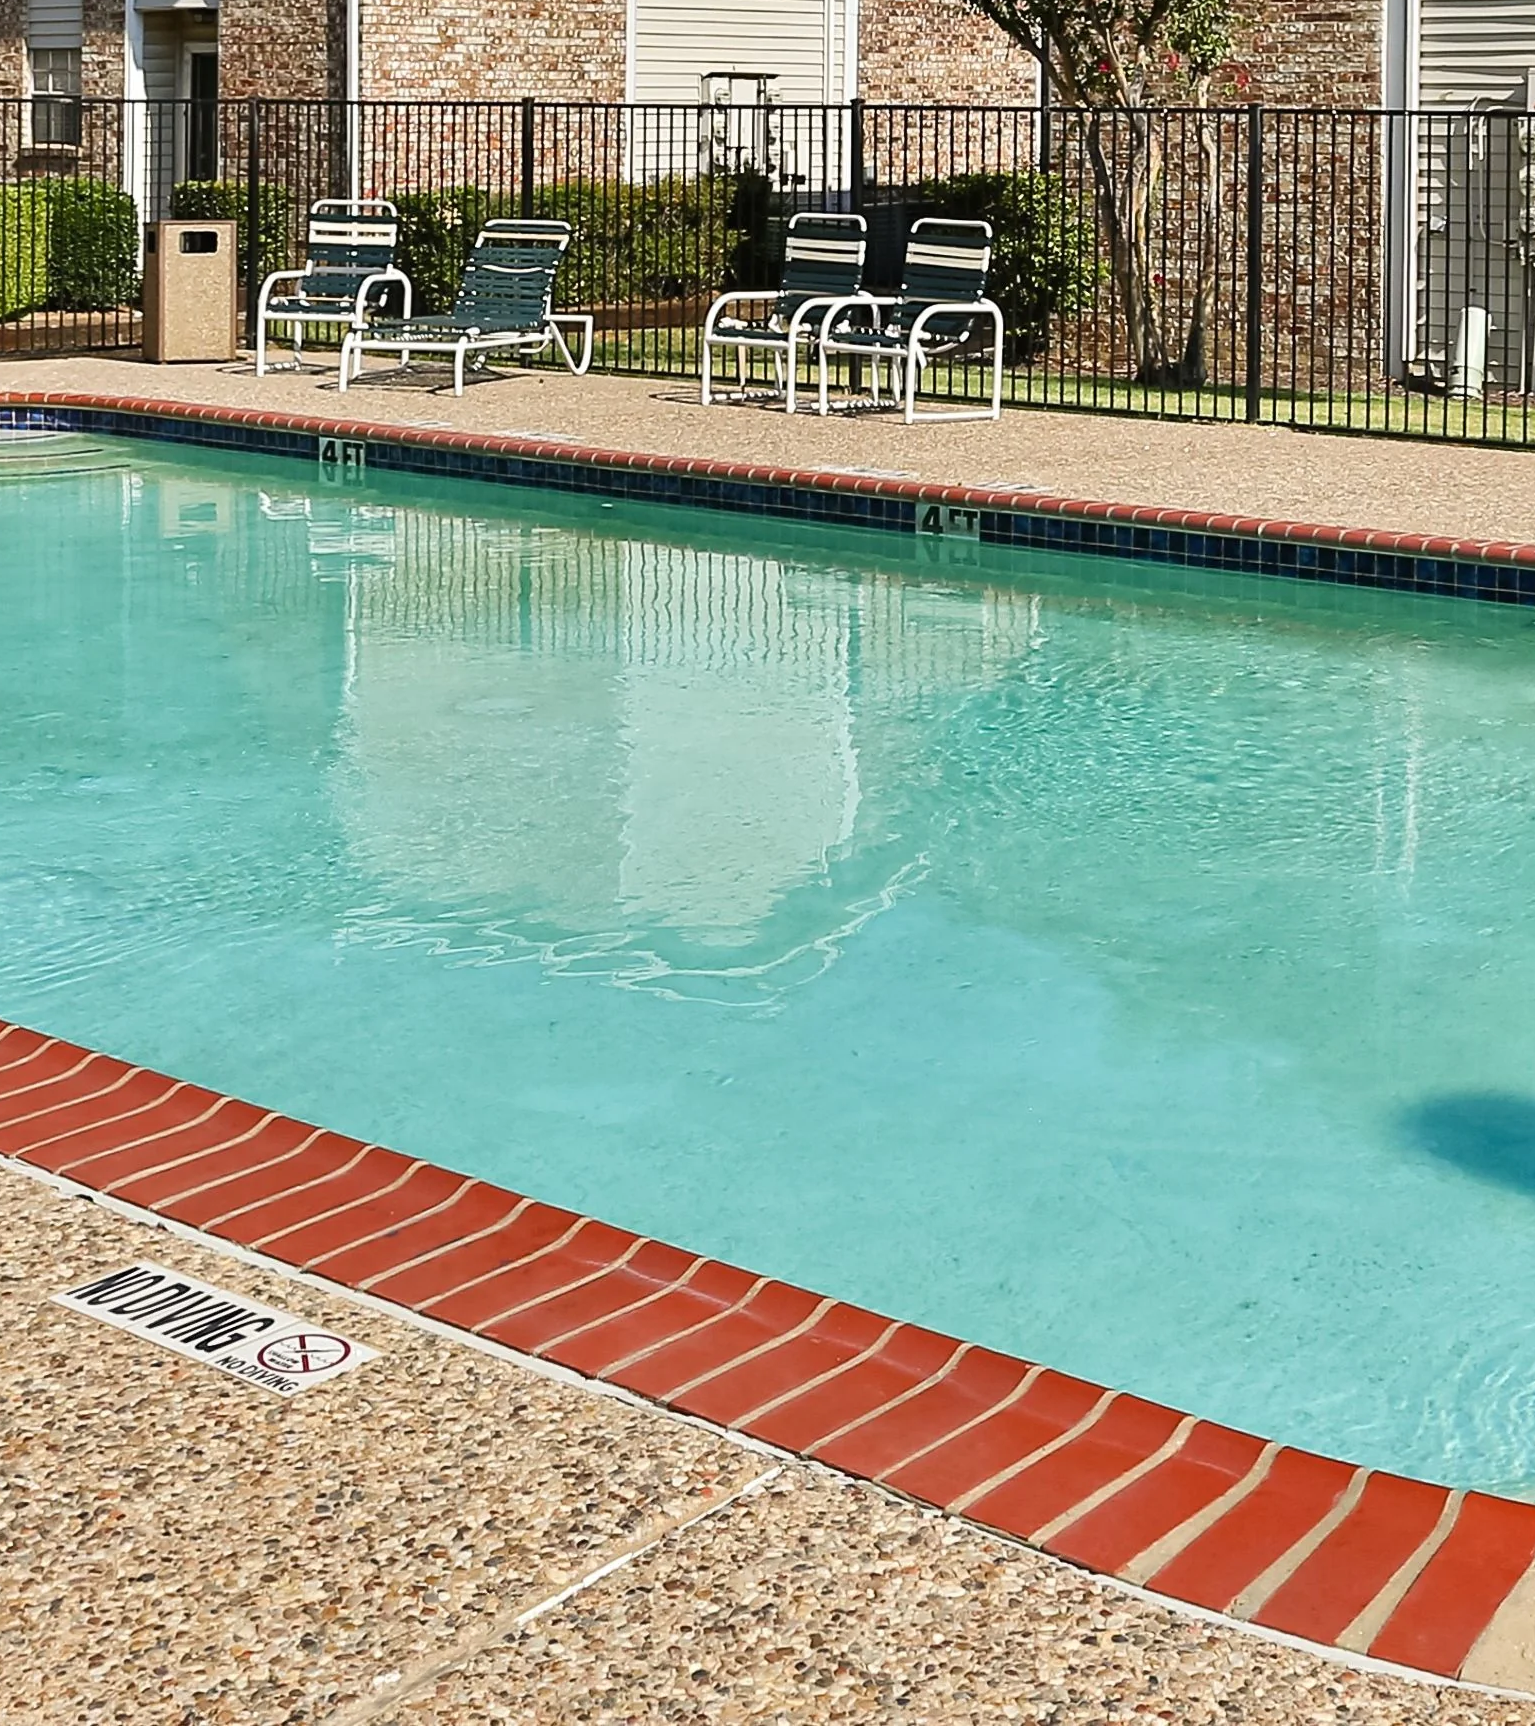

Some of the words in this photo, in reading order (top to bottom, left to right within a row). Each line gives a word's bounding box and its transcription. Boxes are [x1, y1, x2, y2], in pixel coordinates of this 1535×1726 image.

[322, 440, 338, 463] 4
[342, 441, 364, 466] FT
[922, 505, 943, 534] 4
[948, 508, 979, 532] FT
[64, 1266, 167, 1306] NO
[107, 1282, 275, 1353] DIVING
[215, 1356, 243, 1369] NO
[240, 1364, 299, 1392] DIVING
